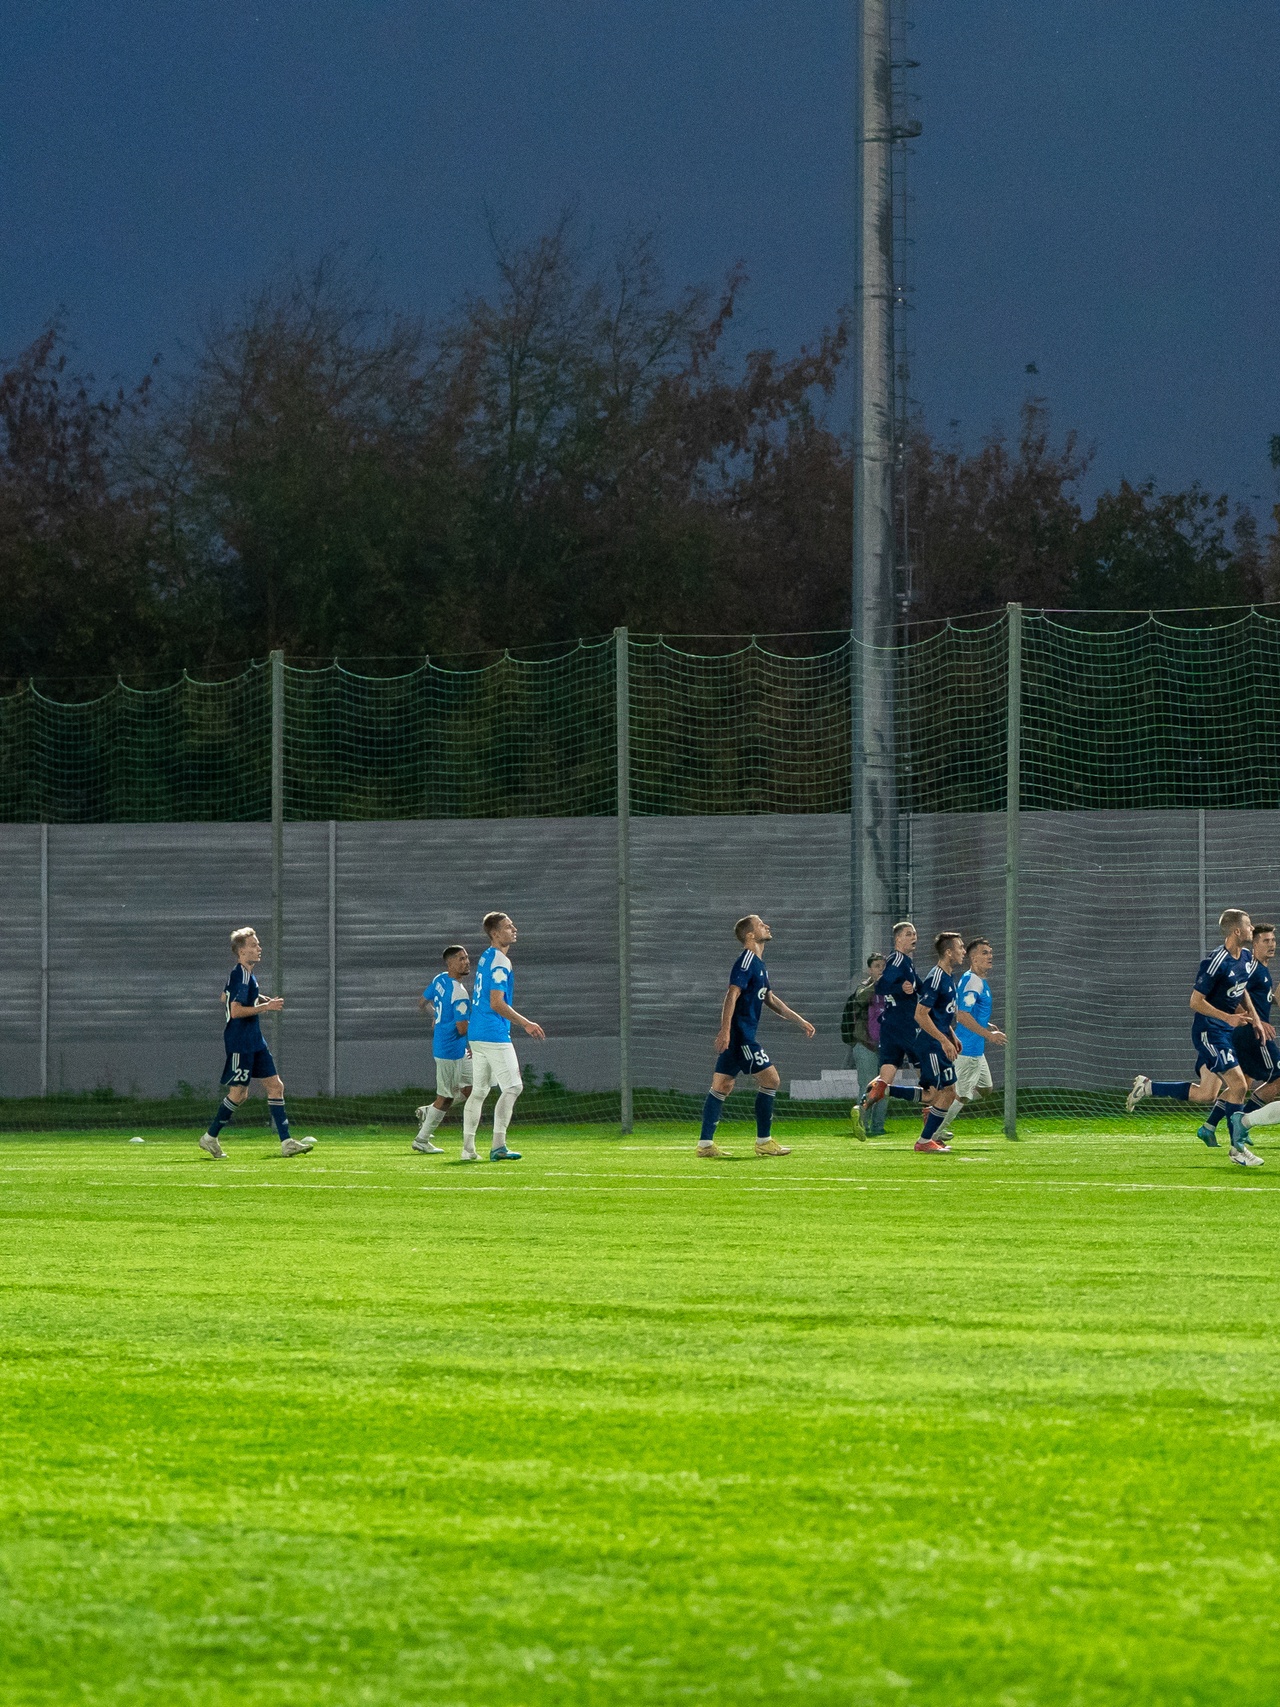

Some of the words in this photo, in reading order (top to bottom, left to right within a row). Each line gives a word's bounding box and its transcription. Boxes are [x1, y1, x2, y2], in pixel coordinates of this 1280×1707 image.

[754, 1049, 770, 1066] 55
[1220, 1048, 1235, 1065] 14
[233, 1068, 250, 1082] 23
[943, 1067, 954, 1081] 17
